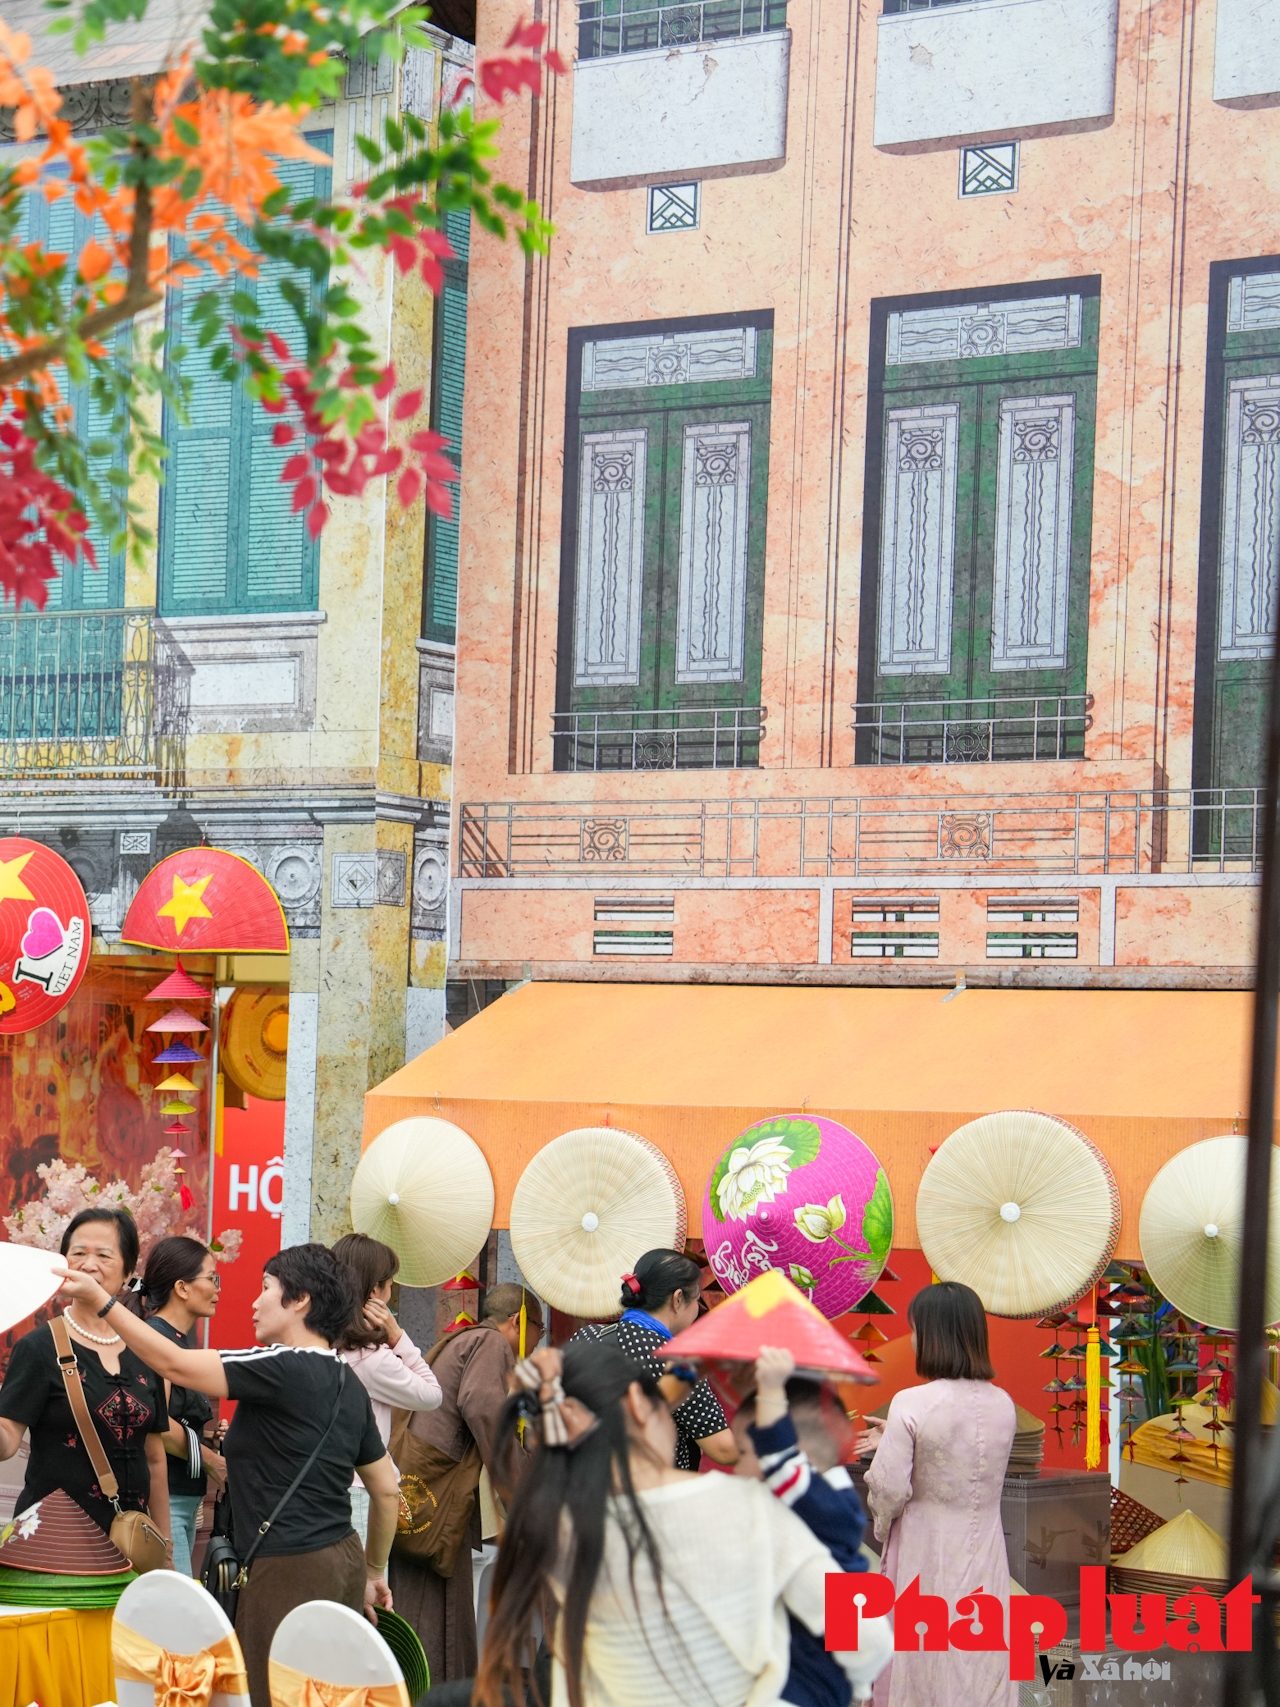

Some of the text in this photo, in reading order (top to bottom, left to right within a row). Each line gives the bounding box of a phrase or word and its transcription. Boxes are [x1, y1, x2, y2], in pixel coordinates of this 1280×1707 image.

[15, 961, 54, 991] I
[52, 921, 81, 994] VIET NAM
